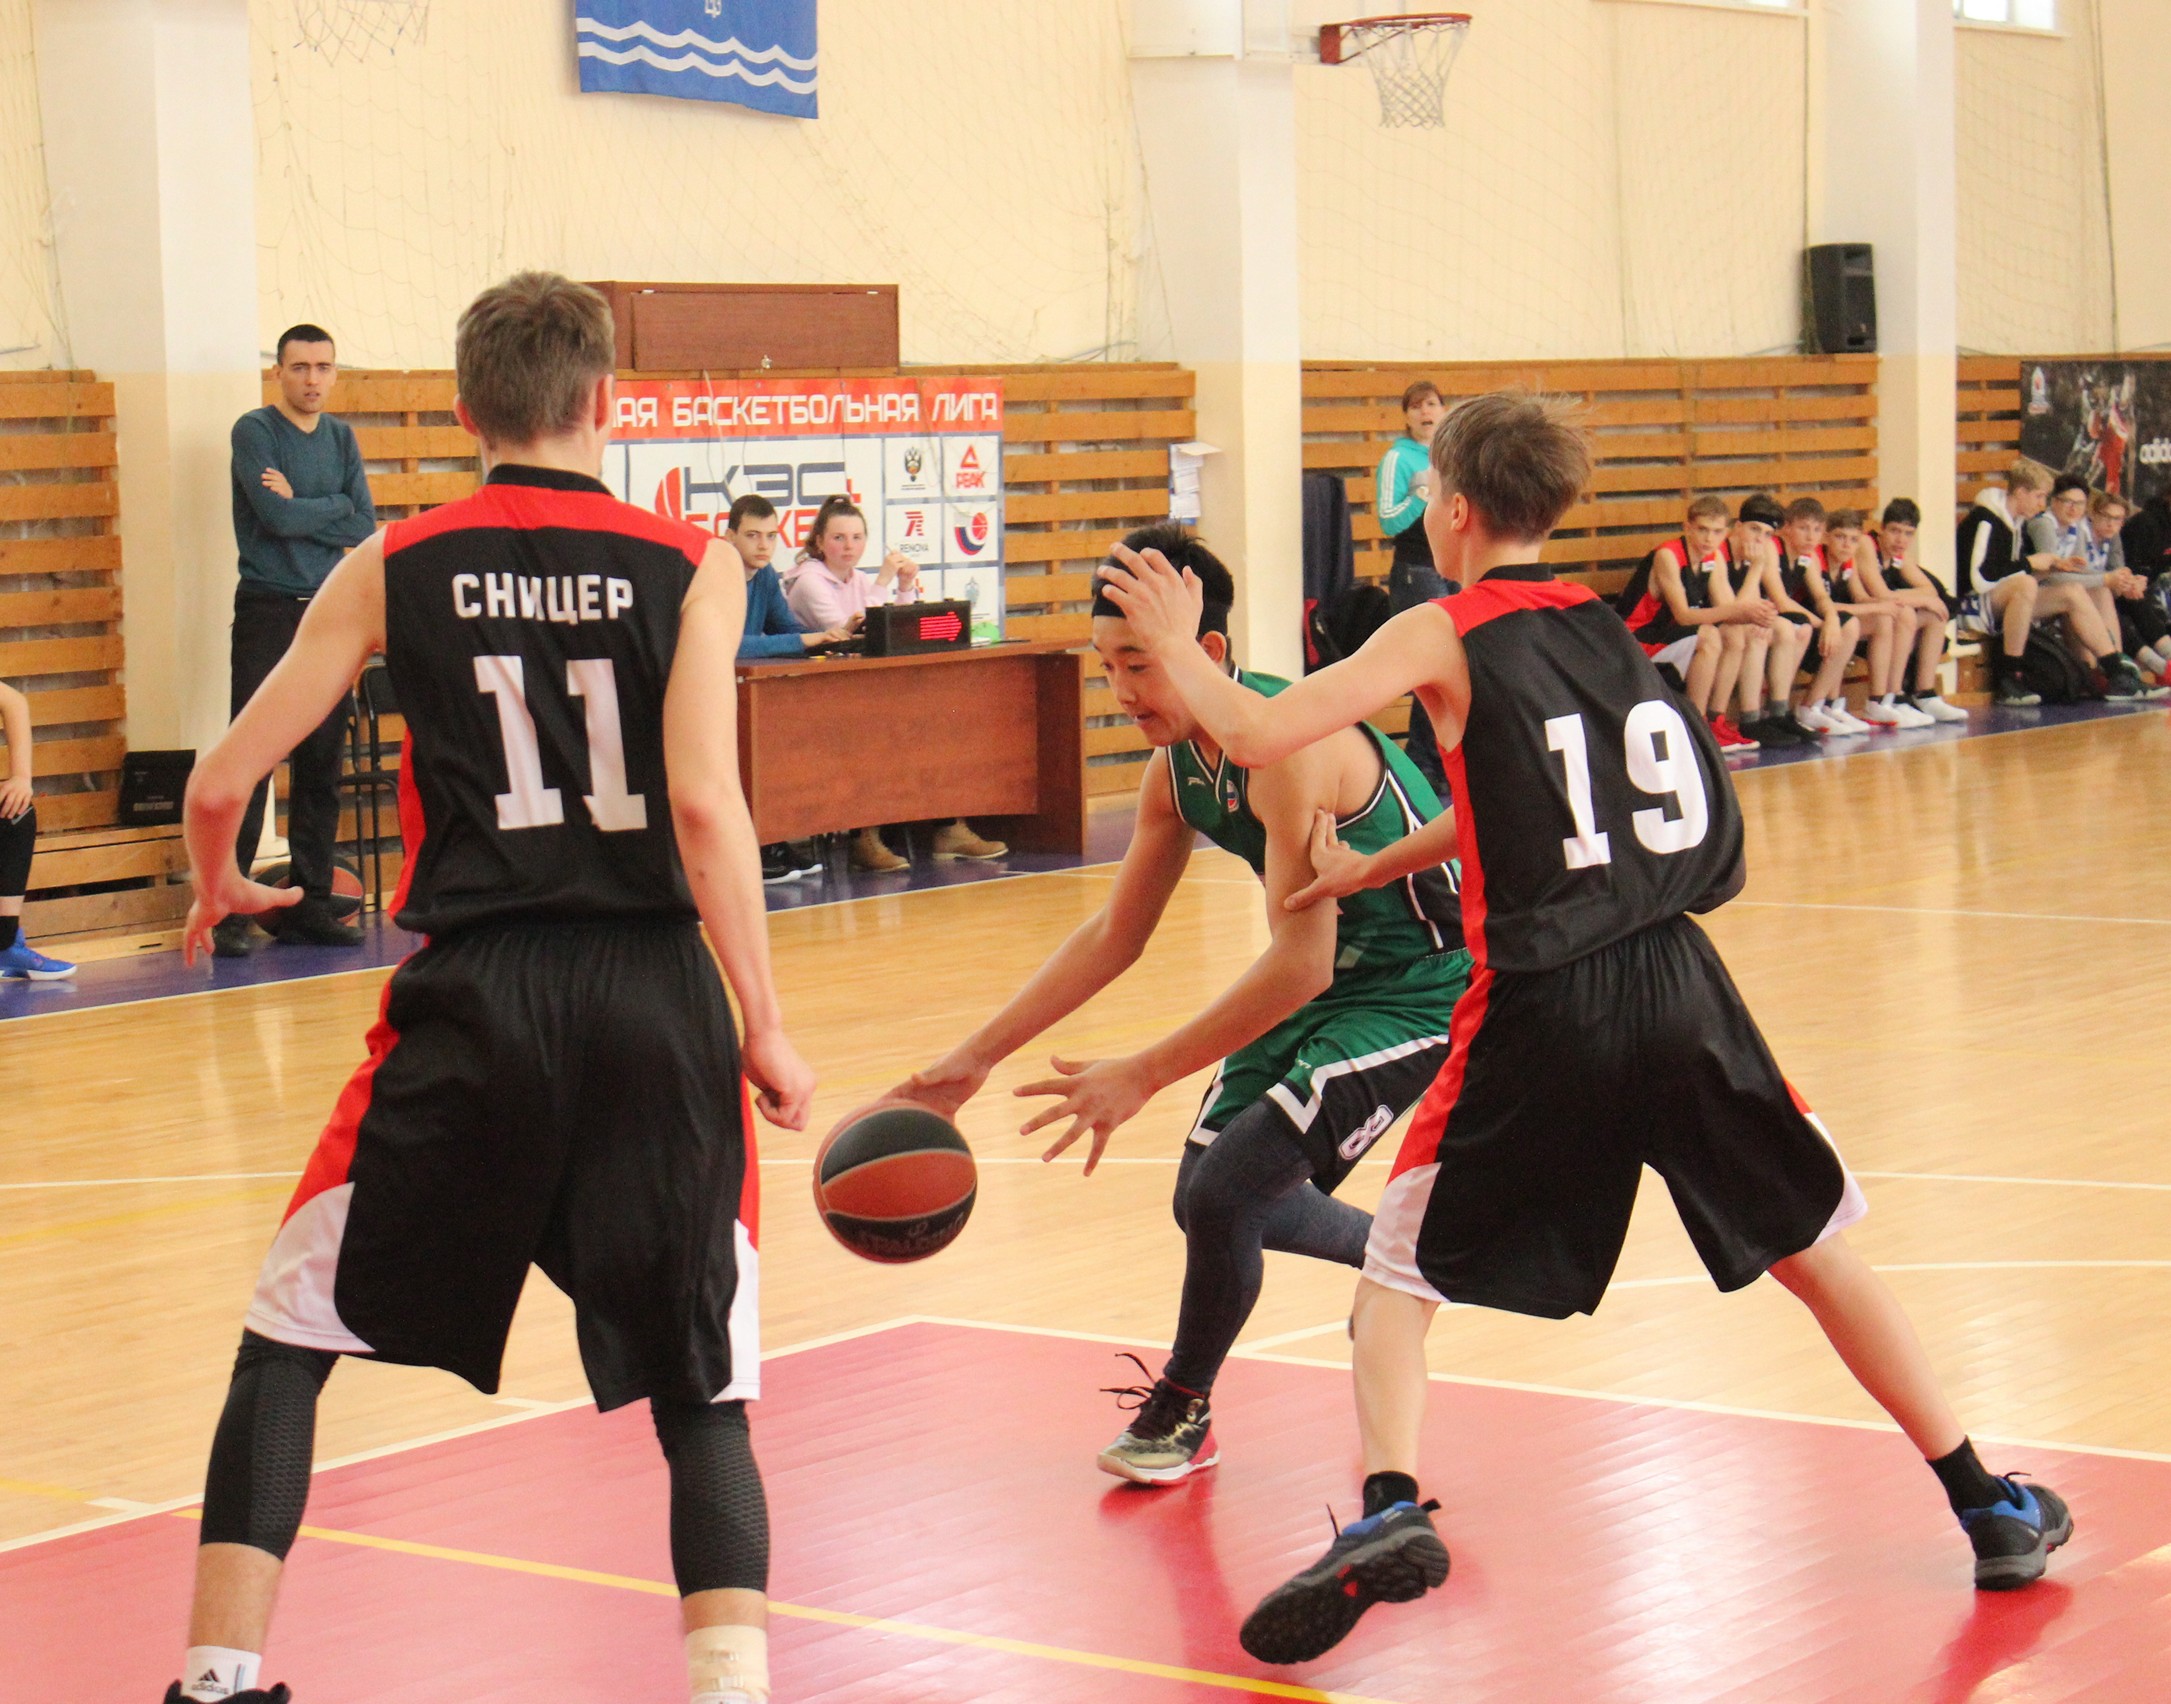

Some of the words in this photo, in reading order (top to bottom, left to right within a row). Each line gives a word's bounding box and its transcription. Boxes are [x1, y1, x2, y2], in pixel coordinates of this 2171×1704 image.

[612, 397, 658, 428] АЯ
[672, 393, 920, 427] БАСКЕТБОЛЬНАЯ
[932, 392, 999, 422] ЛИГА
[2139, 437, 2171, 464] adid
[684, 462, 845, 511] КЭС
[956, 472, 985, 489] PEAK
[452, 572, 634, 625] СНИЦЕР
[473, 654, 648, 832] 11
[1544, 699, 1709, 870] 19
[1338, 1104, 1394, 1160] 8
